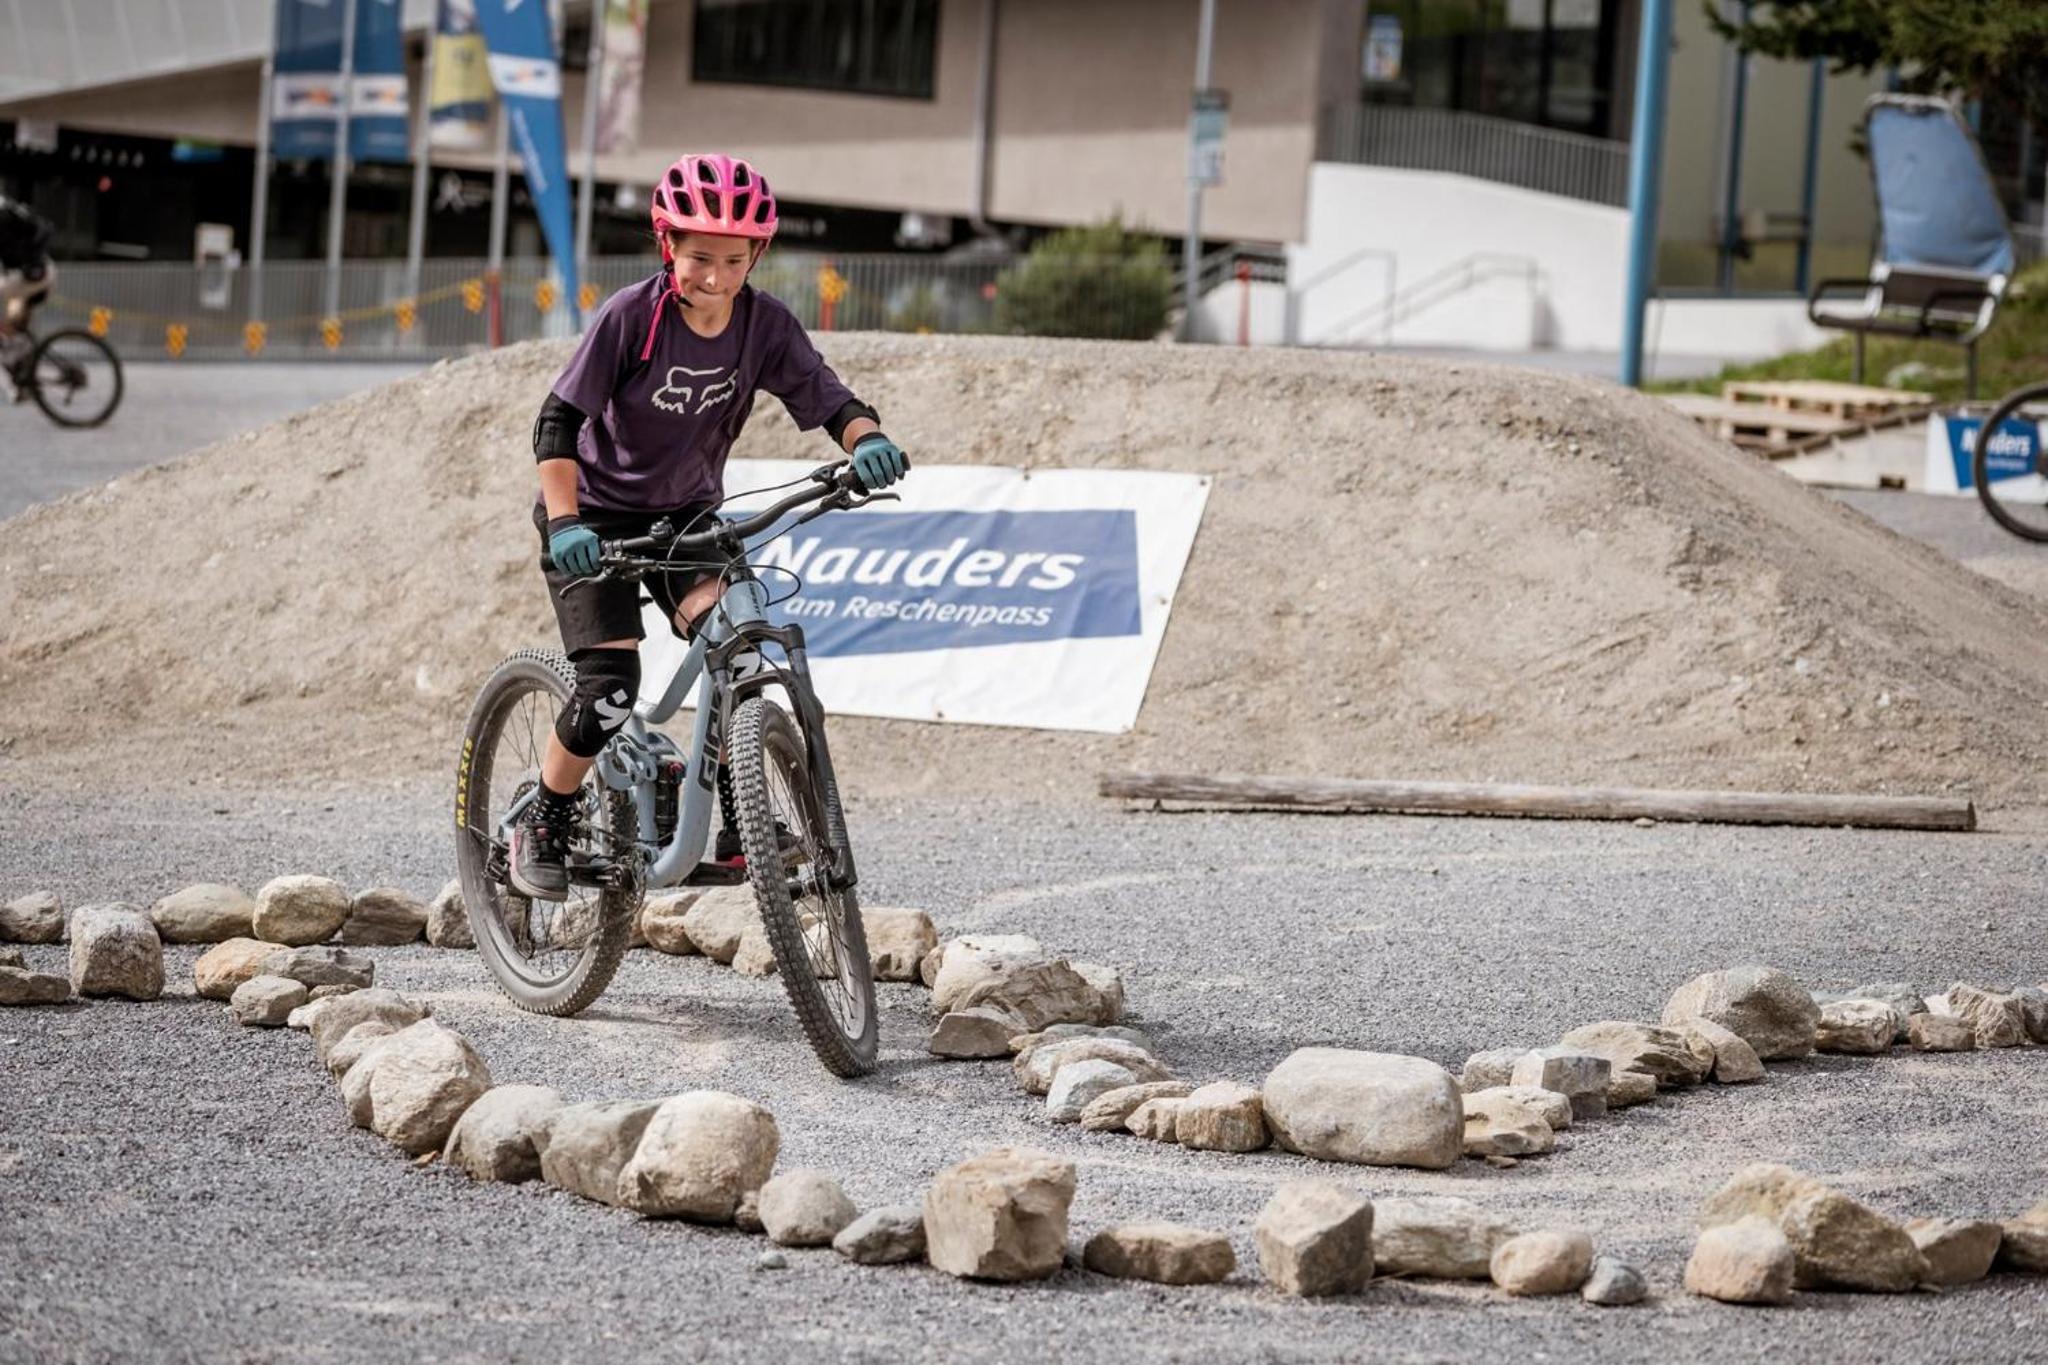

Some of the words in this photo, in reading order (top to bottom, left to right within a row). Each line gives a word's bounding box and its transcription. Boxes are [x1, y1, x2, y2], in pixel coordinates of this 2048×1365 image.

[755, 534, 1085, 590] Nauders
[783, 597, 836, 617] am
[842, 595, 1053, 628] Reschenpass
[457, 737, 473, 828] MAXXIS
